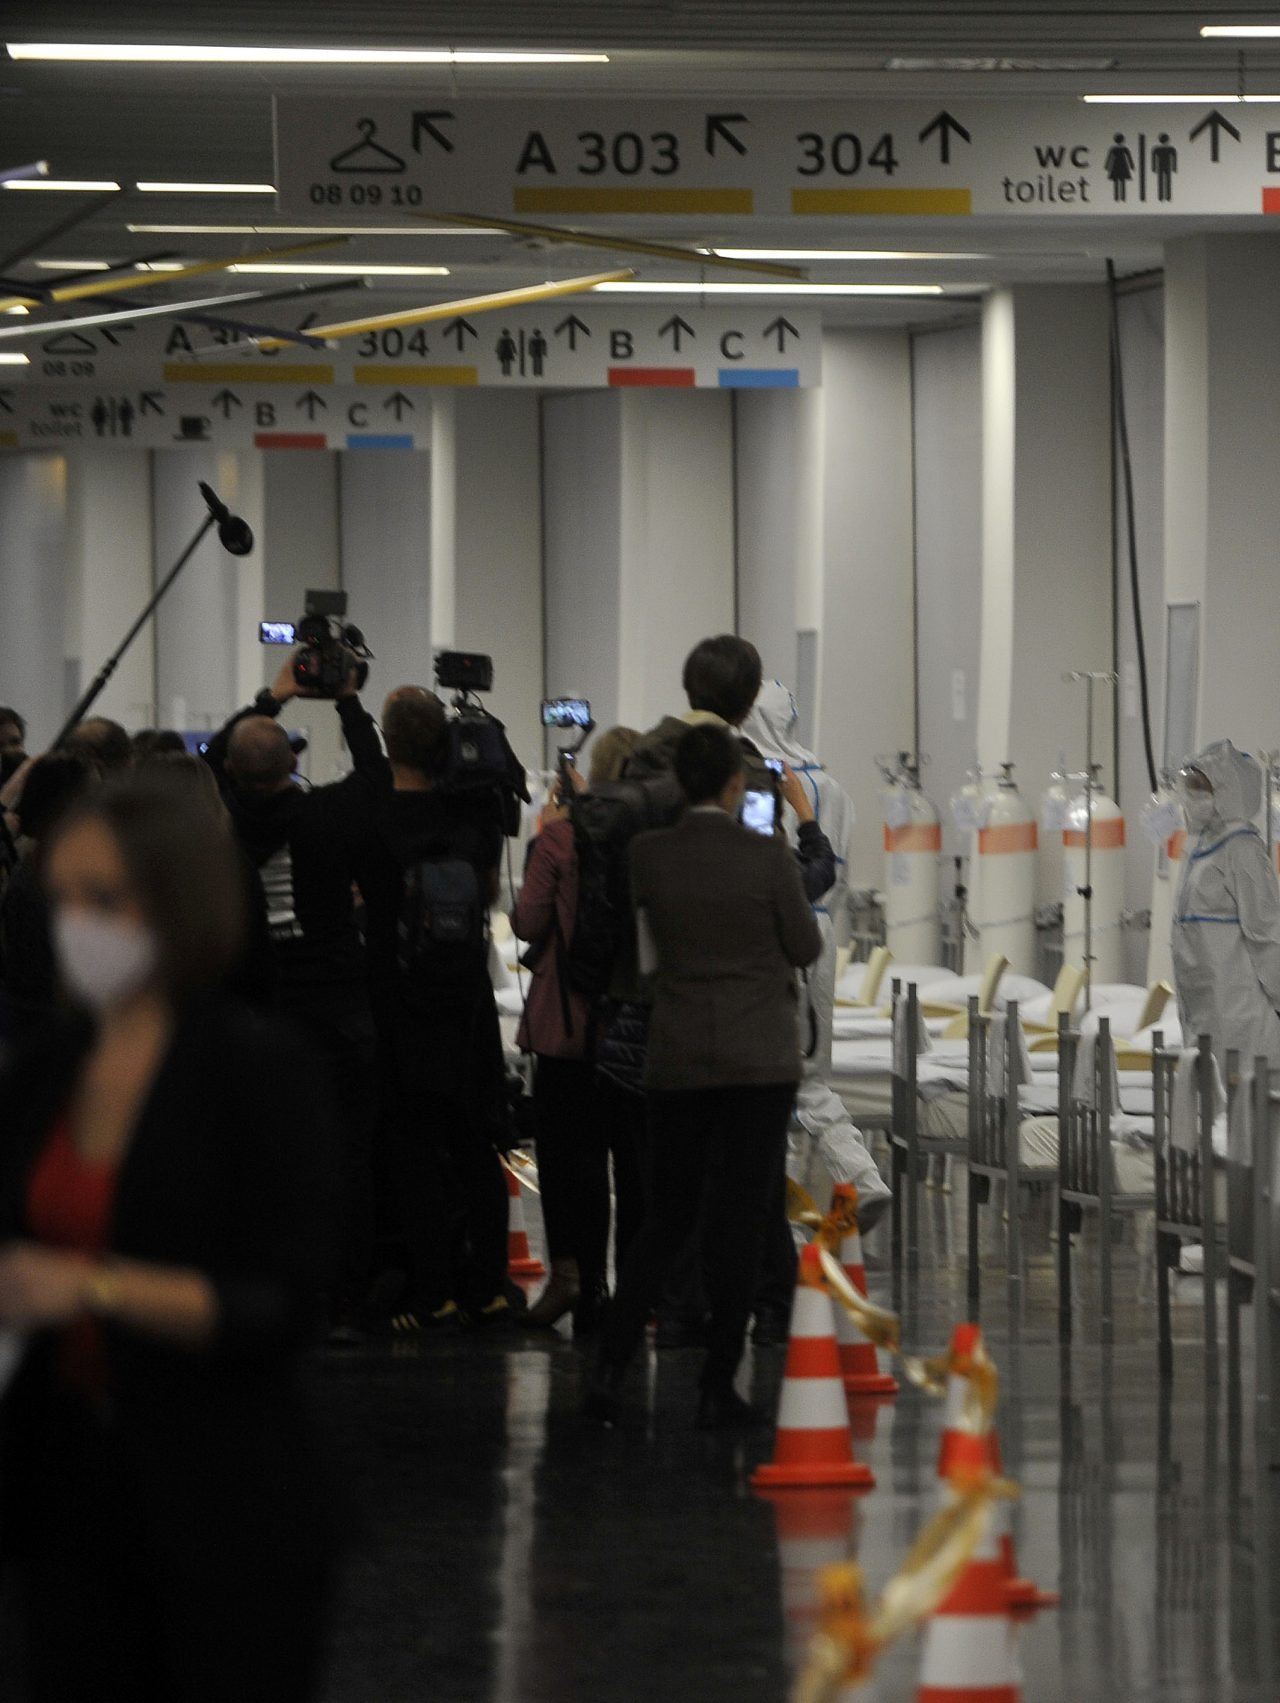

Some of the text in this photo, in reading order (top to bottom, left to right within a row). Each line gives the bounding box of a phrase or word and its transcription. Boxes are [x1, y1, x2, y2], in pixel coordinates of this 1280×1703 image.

[515, 131, 680, 176] A 303
[795, 132, 900, 177] 304
[309, 184, 423, 206] 08 09 10
[1002, 174, 1091, 203] toilet
[165, 323, 193, 356] A
[357, 326, 430, 359] 304
[609, 328, 635, 359] B
[719, 329, 745, 361] C
[255, 402, 276, 427] B
[347, 402, 369, 427] C
